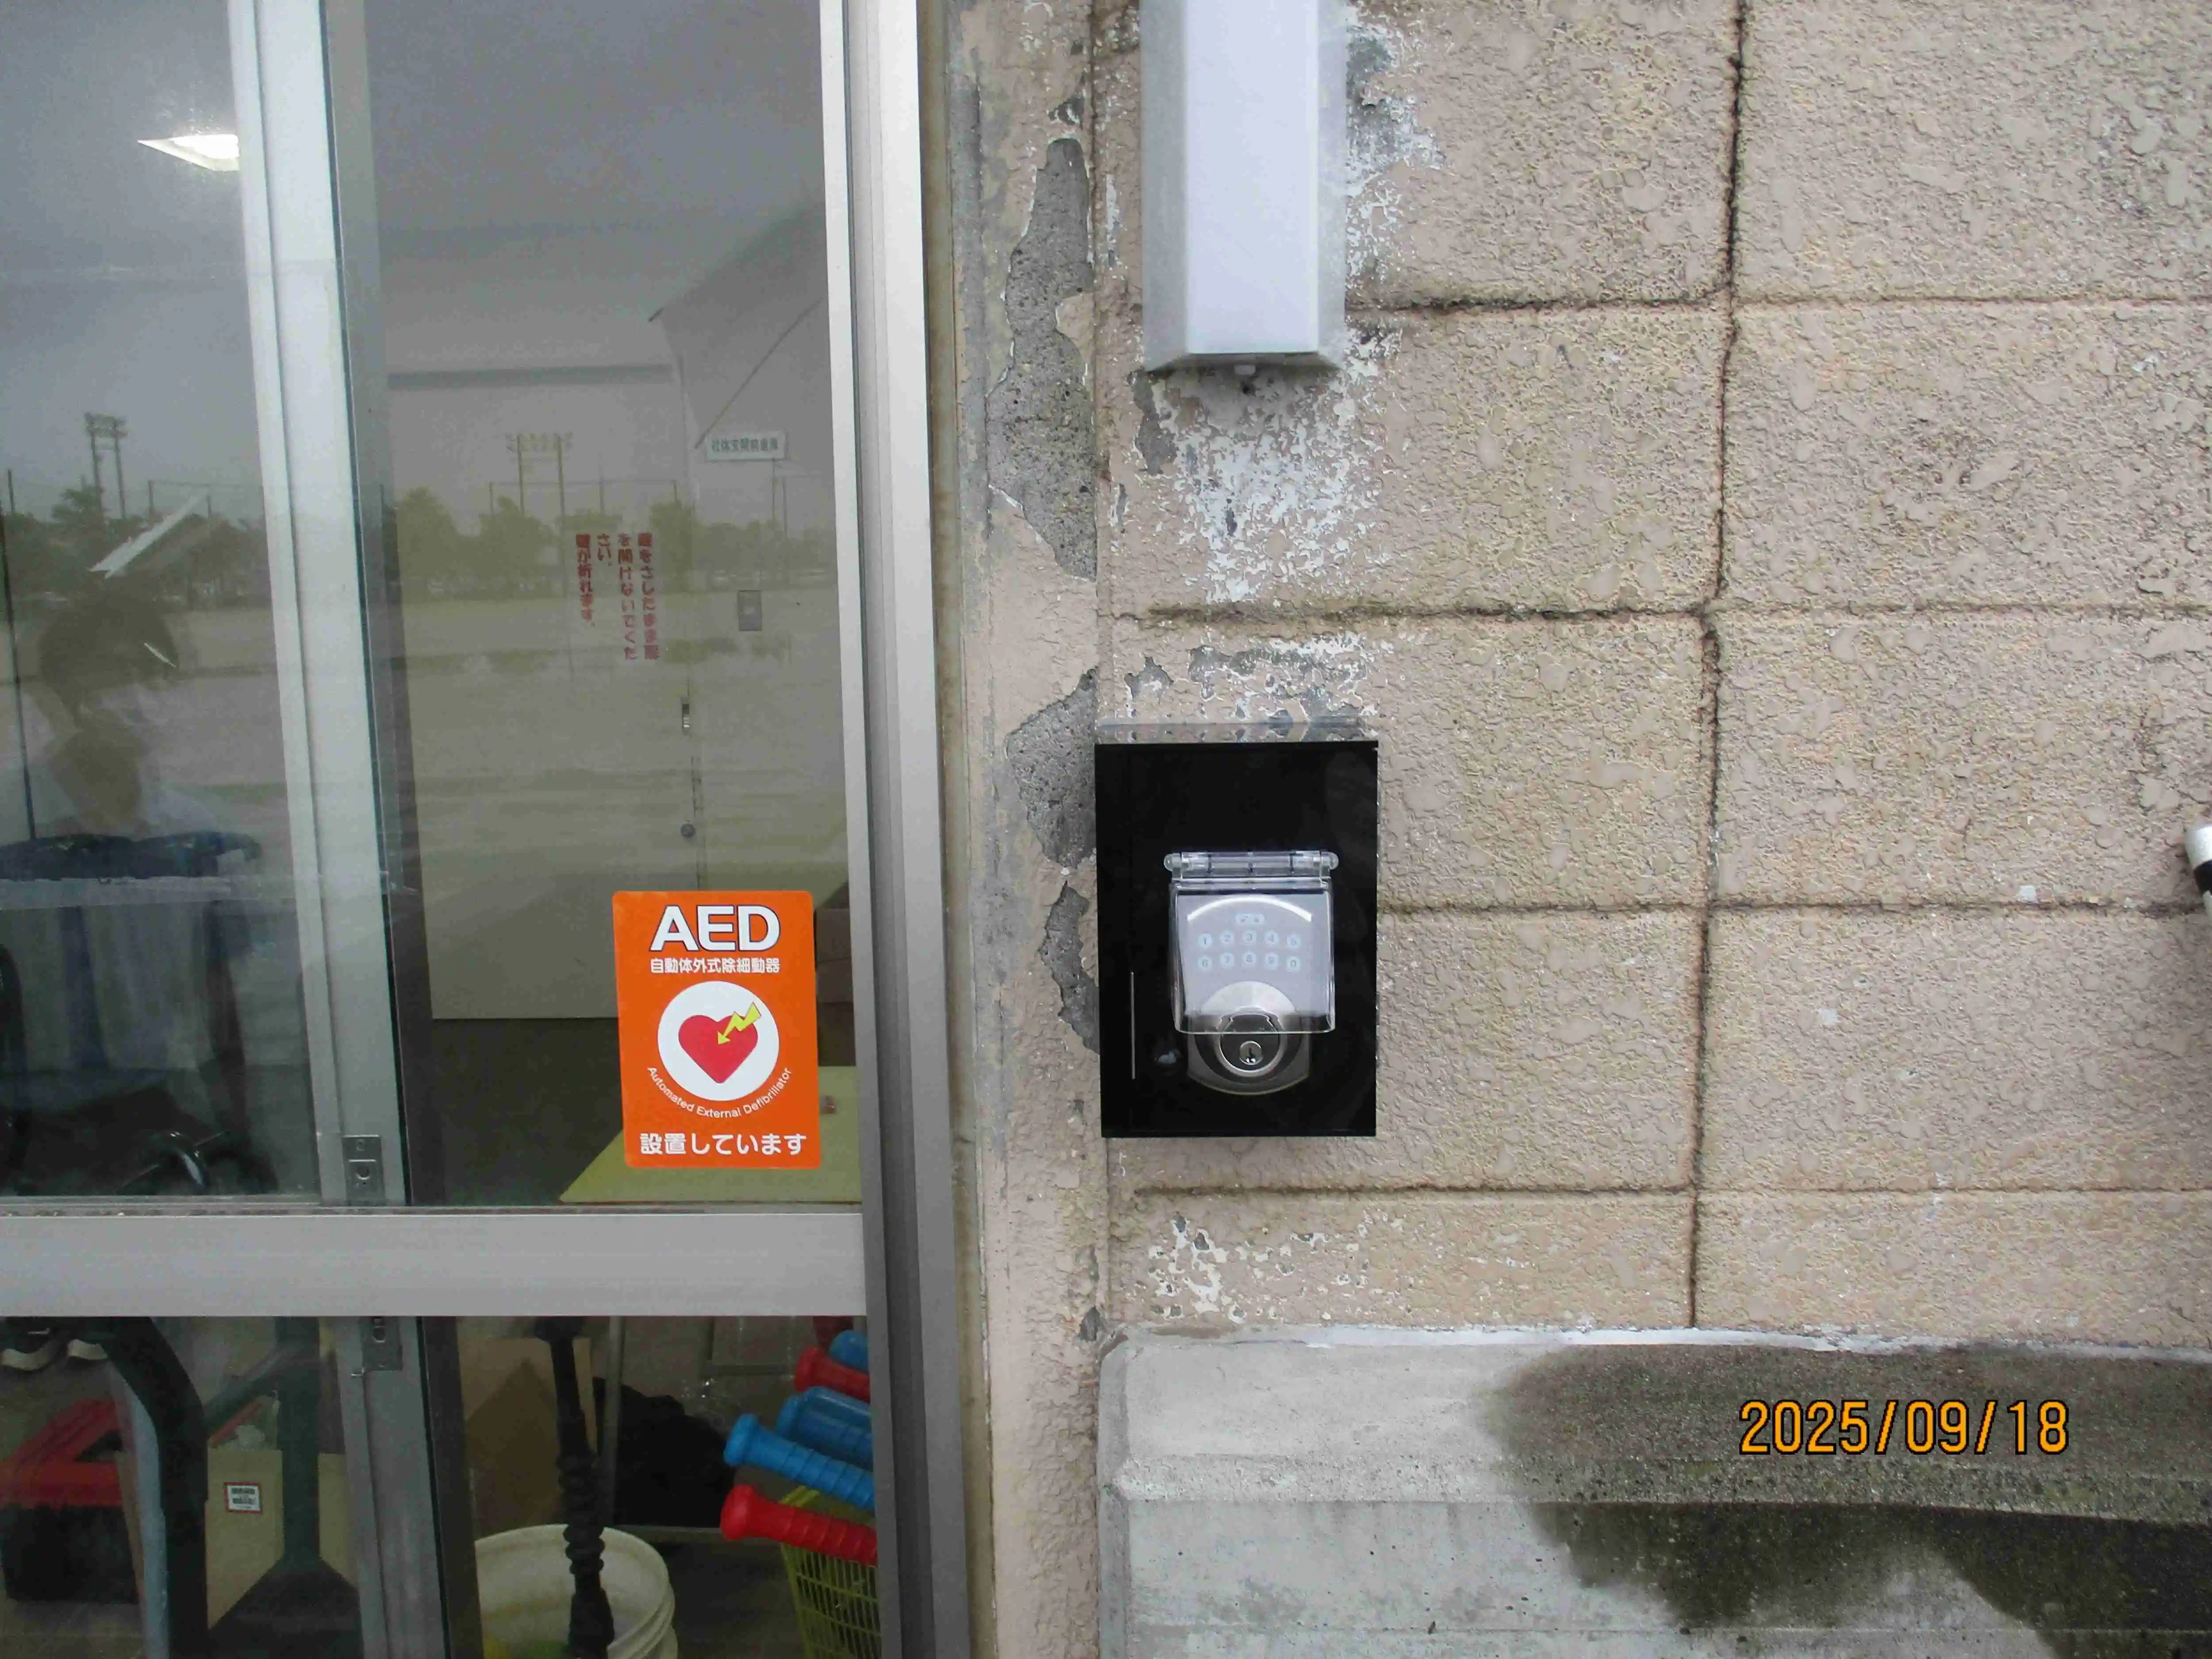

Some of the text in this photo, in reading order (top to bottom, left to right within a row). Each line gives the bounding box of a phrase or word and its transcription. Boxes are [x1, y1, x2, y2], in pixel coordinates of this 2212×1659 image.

[649, 905, 780, 952] AED
[650, 957, 780, 974] 自動体外式除細動器
[647, 1066, 792, 1118] Automated External Defibrillator
[639, 1133, 806, 1155] 設置しています
